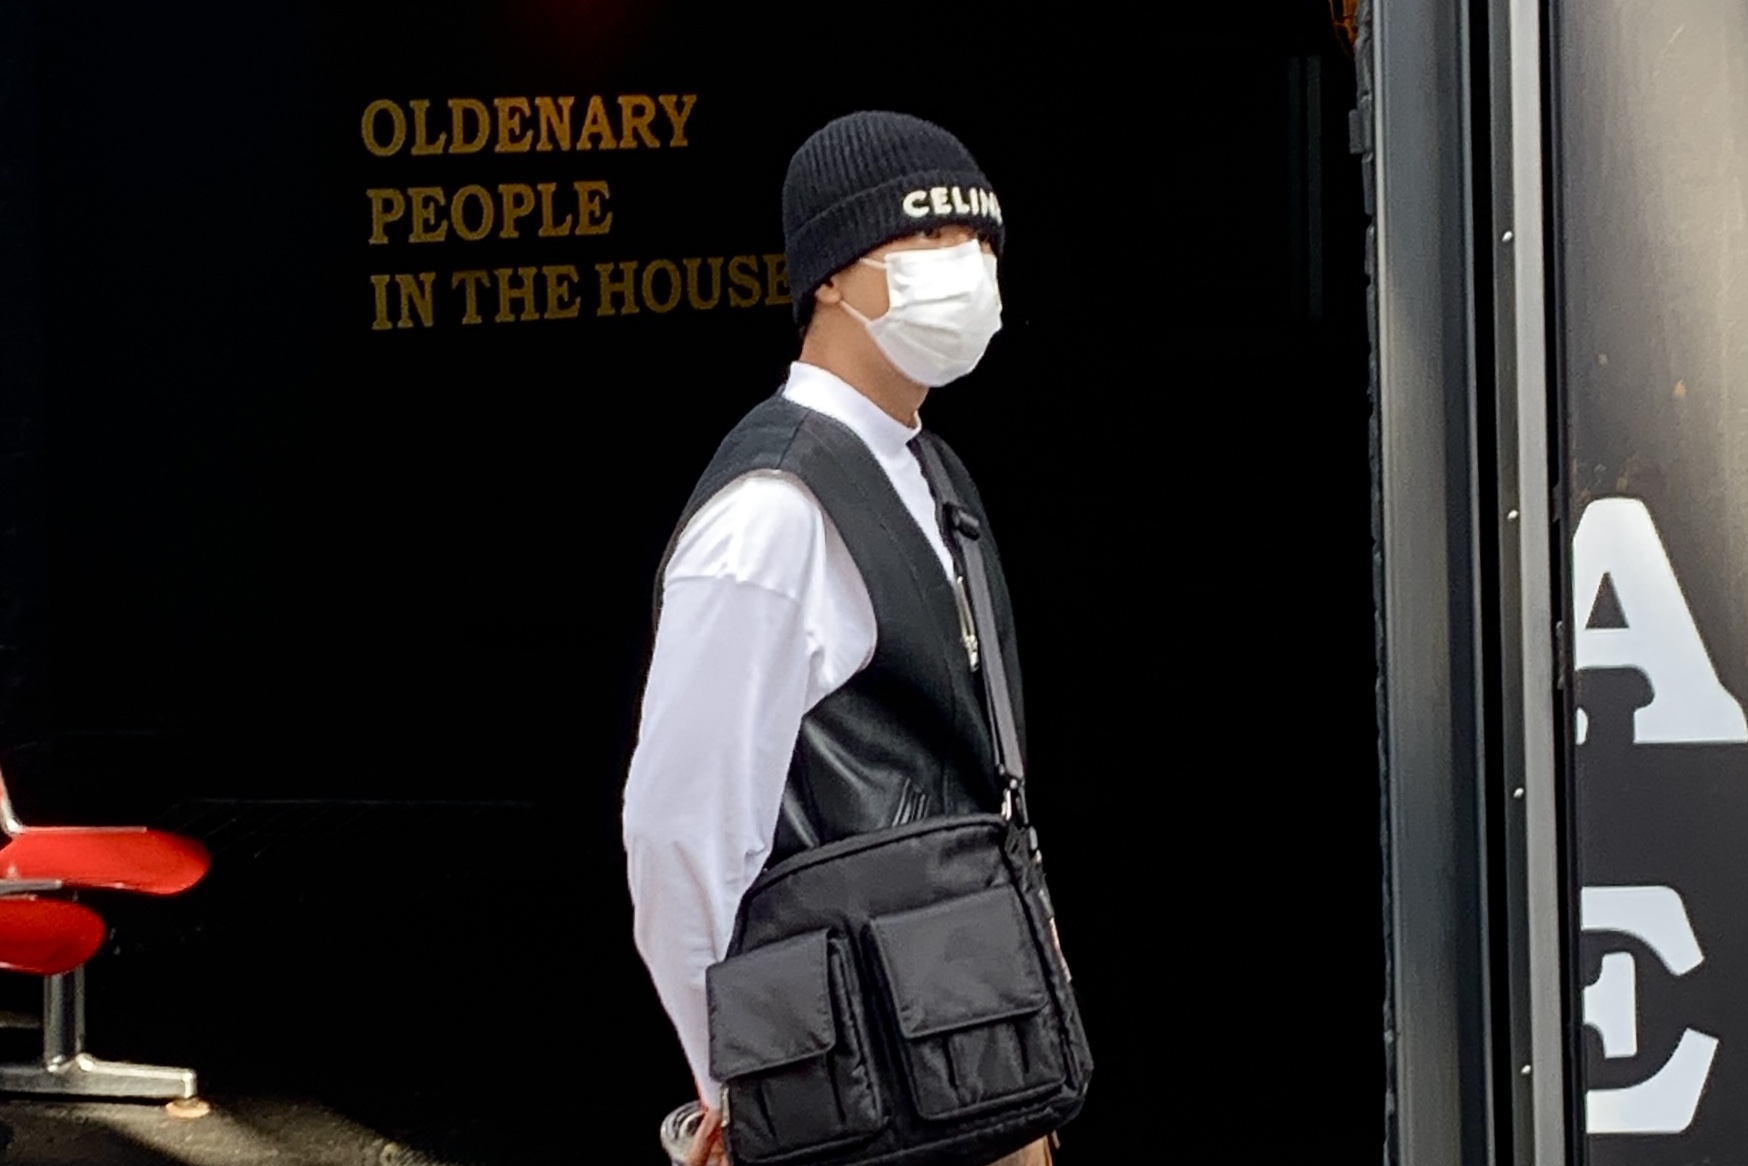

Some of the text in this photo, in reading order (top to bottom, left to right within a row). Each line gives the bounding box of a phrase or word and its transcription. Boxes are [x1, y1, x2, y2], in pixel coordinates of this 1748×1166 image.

[361, 94, 697, 156] OLDENARY
[366, 180, 612, 245] PEOPLE
[368, 252, 792, 330] IN THE HOUSE
